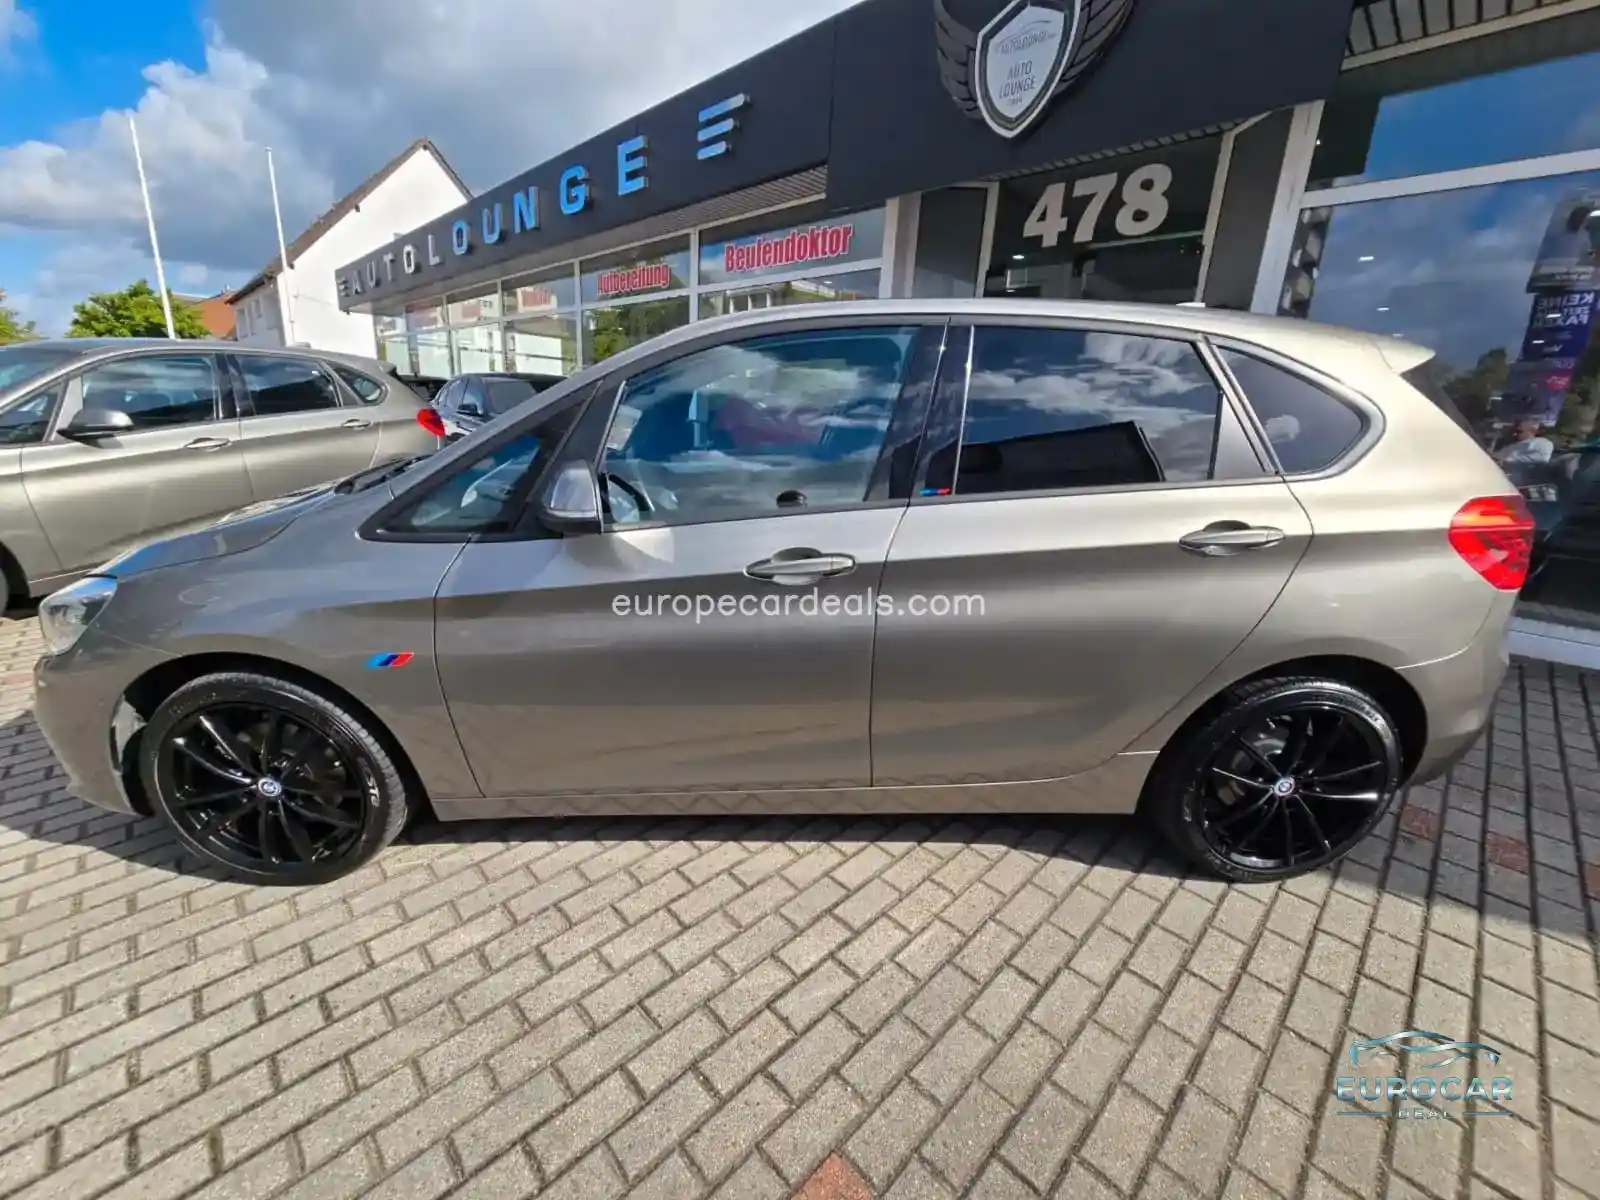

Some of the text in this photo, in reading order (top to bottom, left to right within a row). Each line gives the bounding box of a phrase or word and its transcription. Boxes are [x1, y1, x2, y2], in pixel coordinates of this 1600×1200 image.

[1007, 60, 1033, 80] AUTO
[999, 76, 1037, 99] LOUNGE
[1023, 163, 1173, 248] 478
